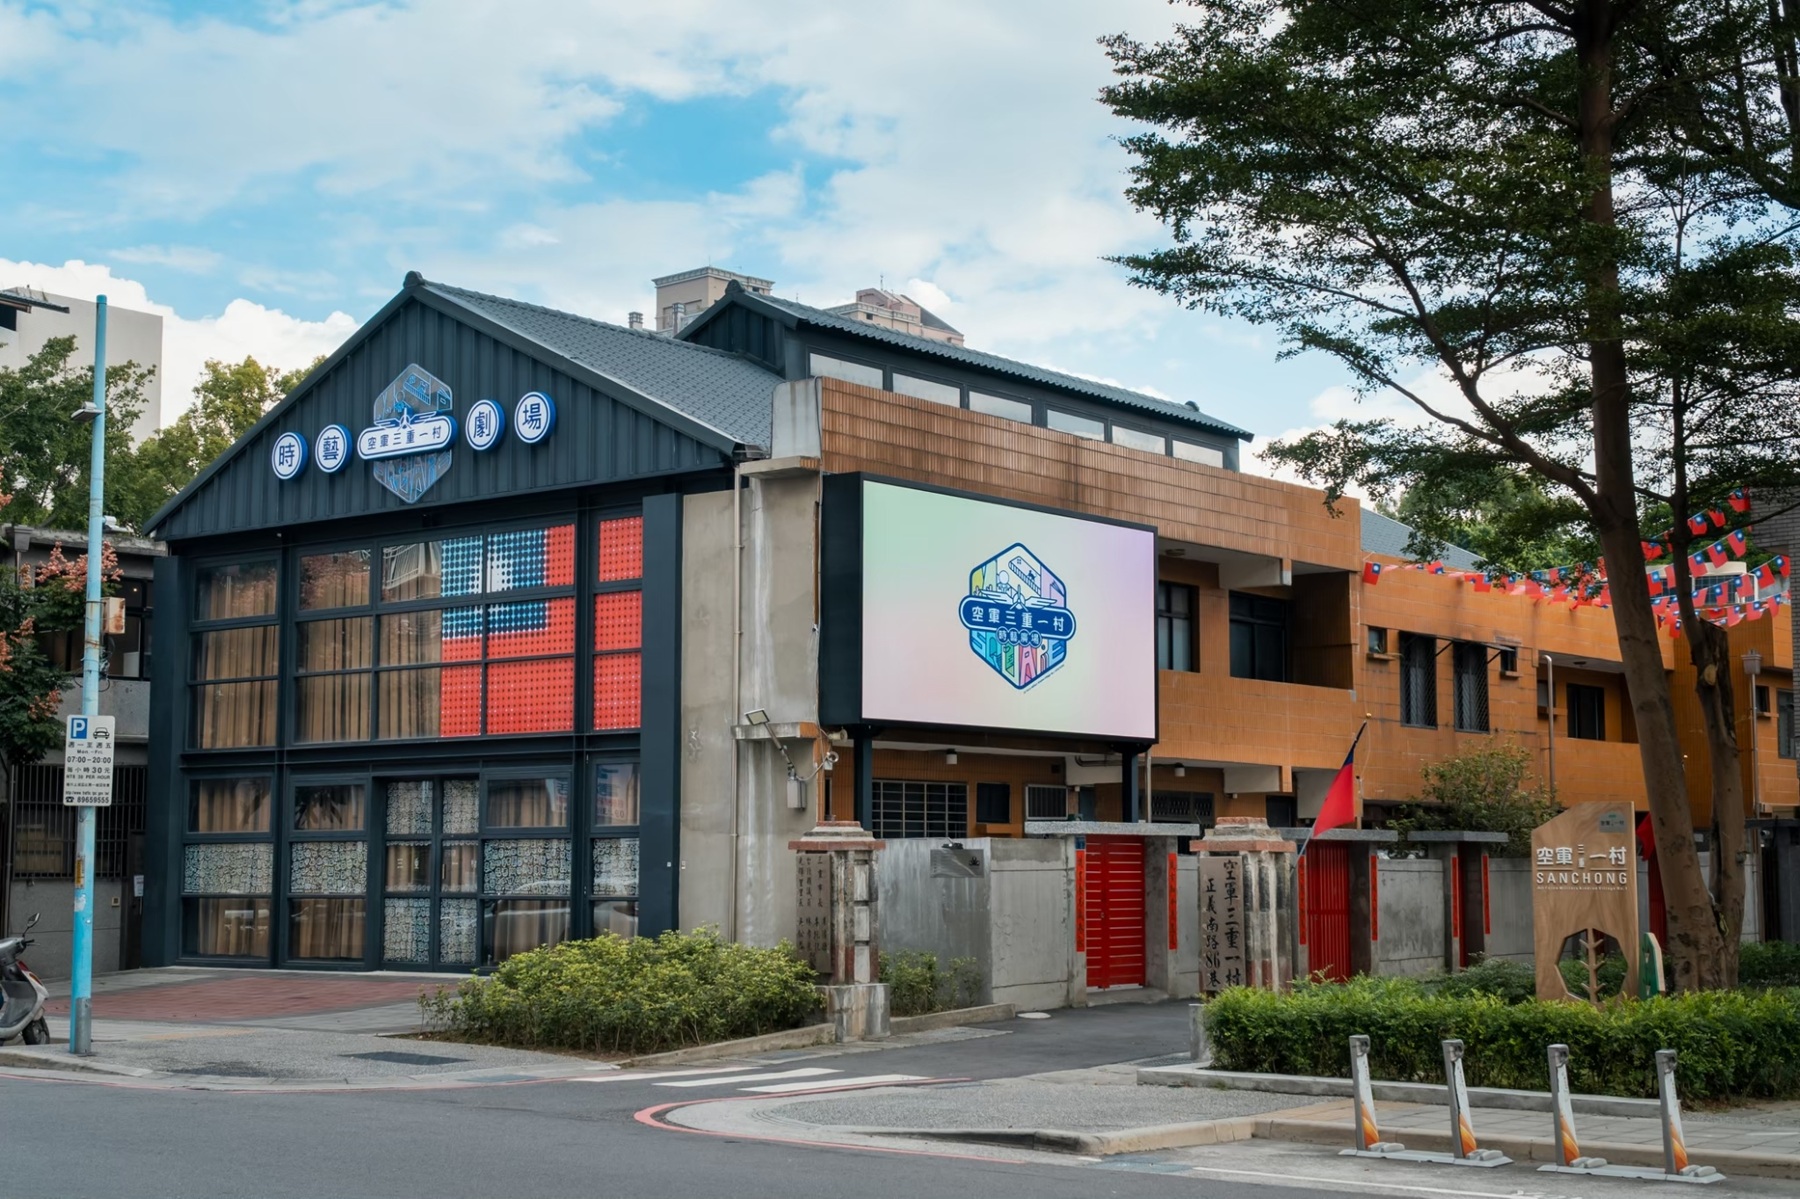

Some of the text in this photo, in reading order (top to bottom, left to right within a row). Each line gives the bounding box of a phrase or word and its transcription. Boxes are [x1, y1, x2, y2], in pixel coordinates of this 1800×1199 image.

[367, 425, 442, 450] 空軍三重一村
[971, 606, 1065, 632] 空軍三重一村
[1536, 872, 1628, 884] SANCHONG
[1205, 877, 1221, 988] 正義南路86巷
[1223, 859, 1241, 987] 空軍三重一村
